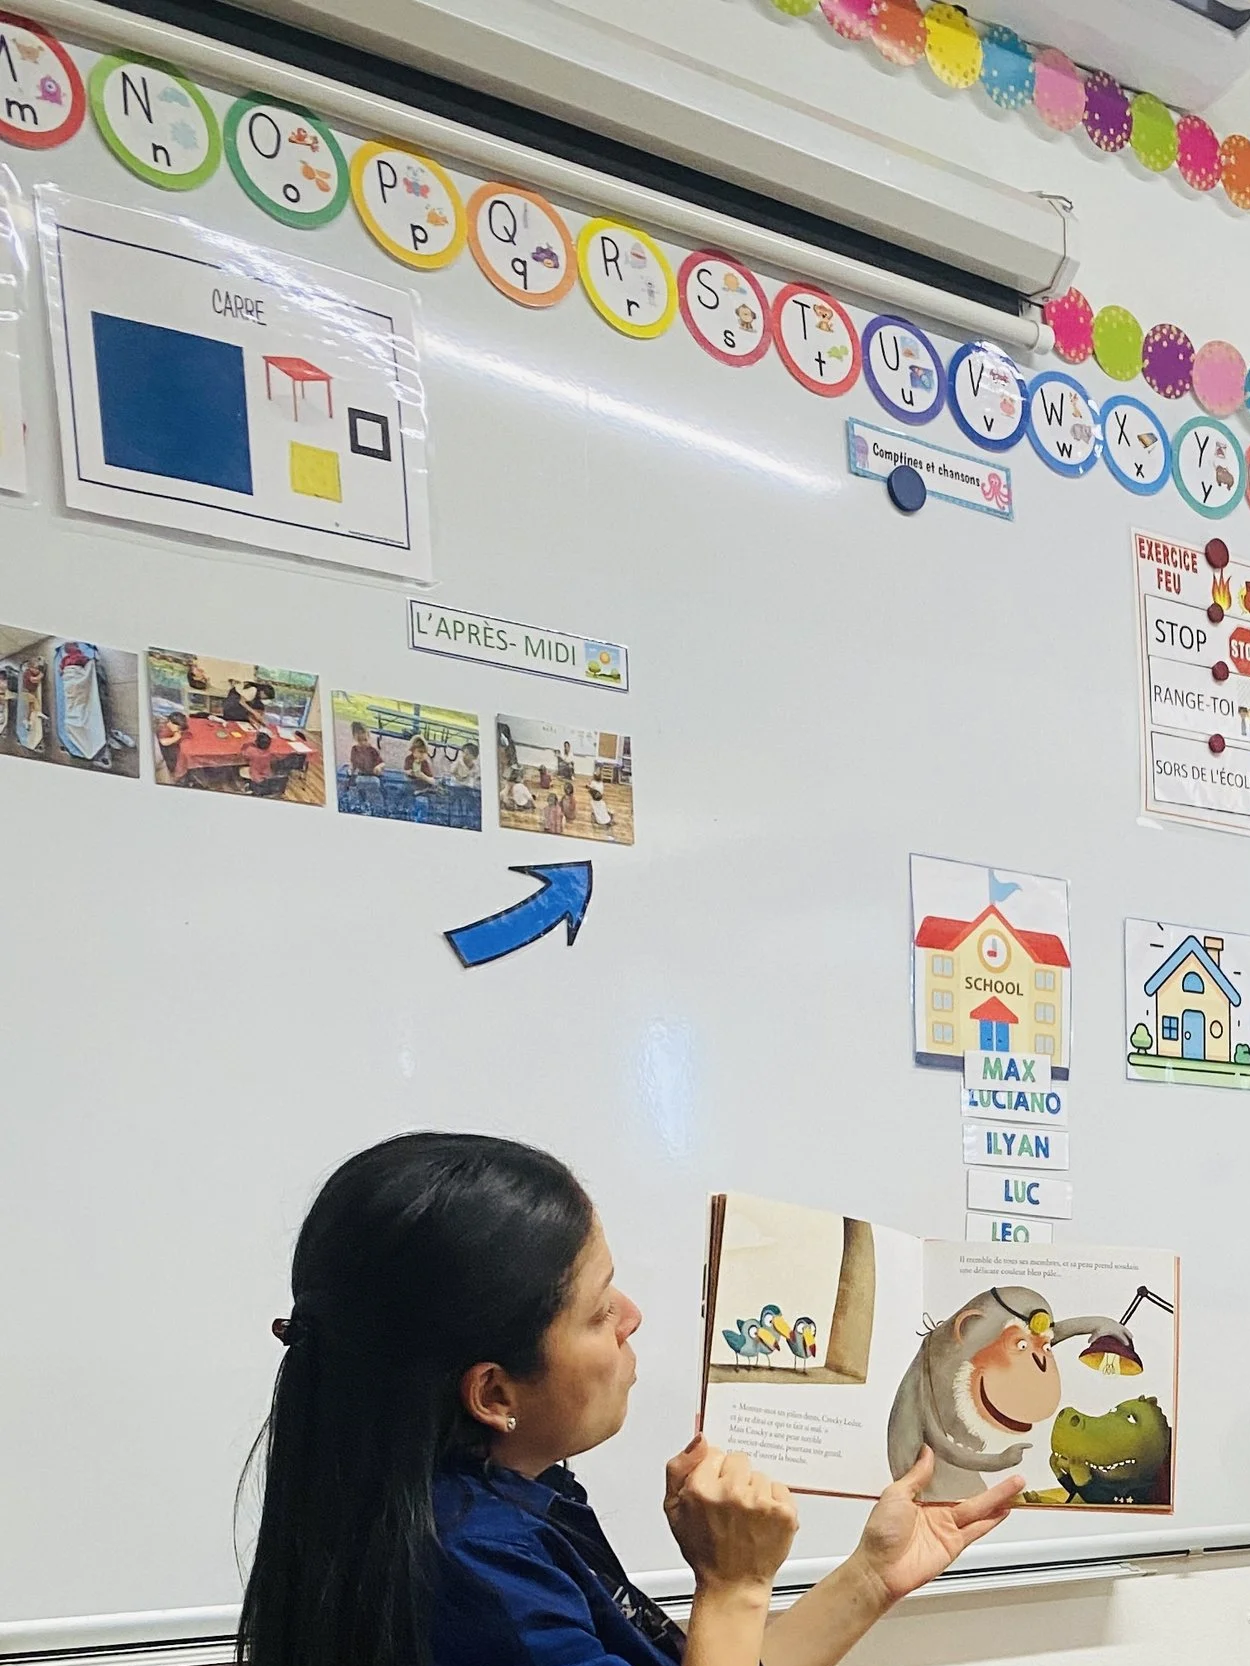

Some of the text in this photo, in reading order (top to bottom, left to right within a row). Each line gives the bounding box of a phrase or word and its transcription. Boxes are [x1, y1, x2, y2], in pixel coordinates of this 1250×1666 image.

[5, 97, 38, 125] m
[121, 71, 153, 124] N
[249, 112, 281, 159] O
[152, 142, 171, 167] n
[282, 183, 300, 203] o
[376, 159, 397, 203] P
[410, 223, 428, 250] p
[488, 200, 517, 245] Q
[600, 235, 623, 281] R
[511, 257, 528, 290] q
[696, 268, 720, 310] S
[626, 297, 640, 316] r
[792, 299, 811, 340] T
[723, 329, 736, 348] s
[879, 331, 900, 371] U
[814, 350, 826, 377] t
[968, 359, 984, 397] V
[901, 387, 914, 406] u
[1040, 388, 1064, 427] W
[983, 414, 994, 432] v
[1114, 411, 1130, 447] X
[1056, 440, 1072, 458] w
[1194, 431, 1209, 468] Y
[872, 442, 981, 487] Comptines et chansons
[1134, 462, 1145, 478] x
[1201, 481, 1213, 503] y
[1138, 537, 1198, 574] EXERCICE
[1156, 567, 1181, 595] FEU
[1155, 619, 1207, 652] STOP
[524, 635, 577, 666] MIDI
[1153, 684, 1235, 718] RANGE-TOI
[1155, 759, 1188, 779] SORS
[1191, 766, 1207, 782] DE
[965, 976, 1024, 997] SCHOOL
[982, 1057, 1036, 1083] MAX
[969, 1088, 1061, 1115] LUCIANO
[986, 1131, 1050, 1159] ILYAN
[1004, 1179, 1040, 1205] LUC
[991, 1221, 1030, 1243] LEO
